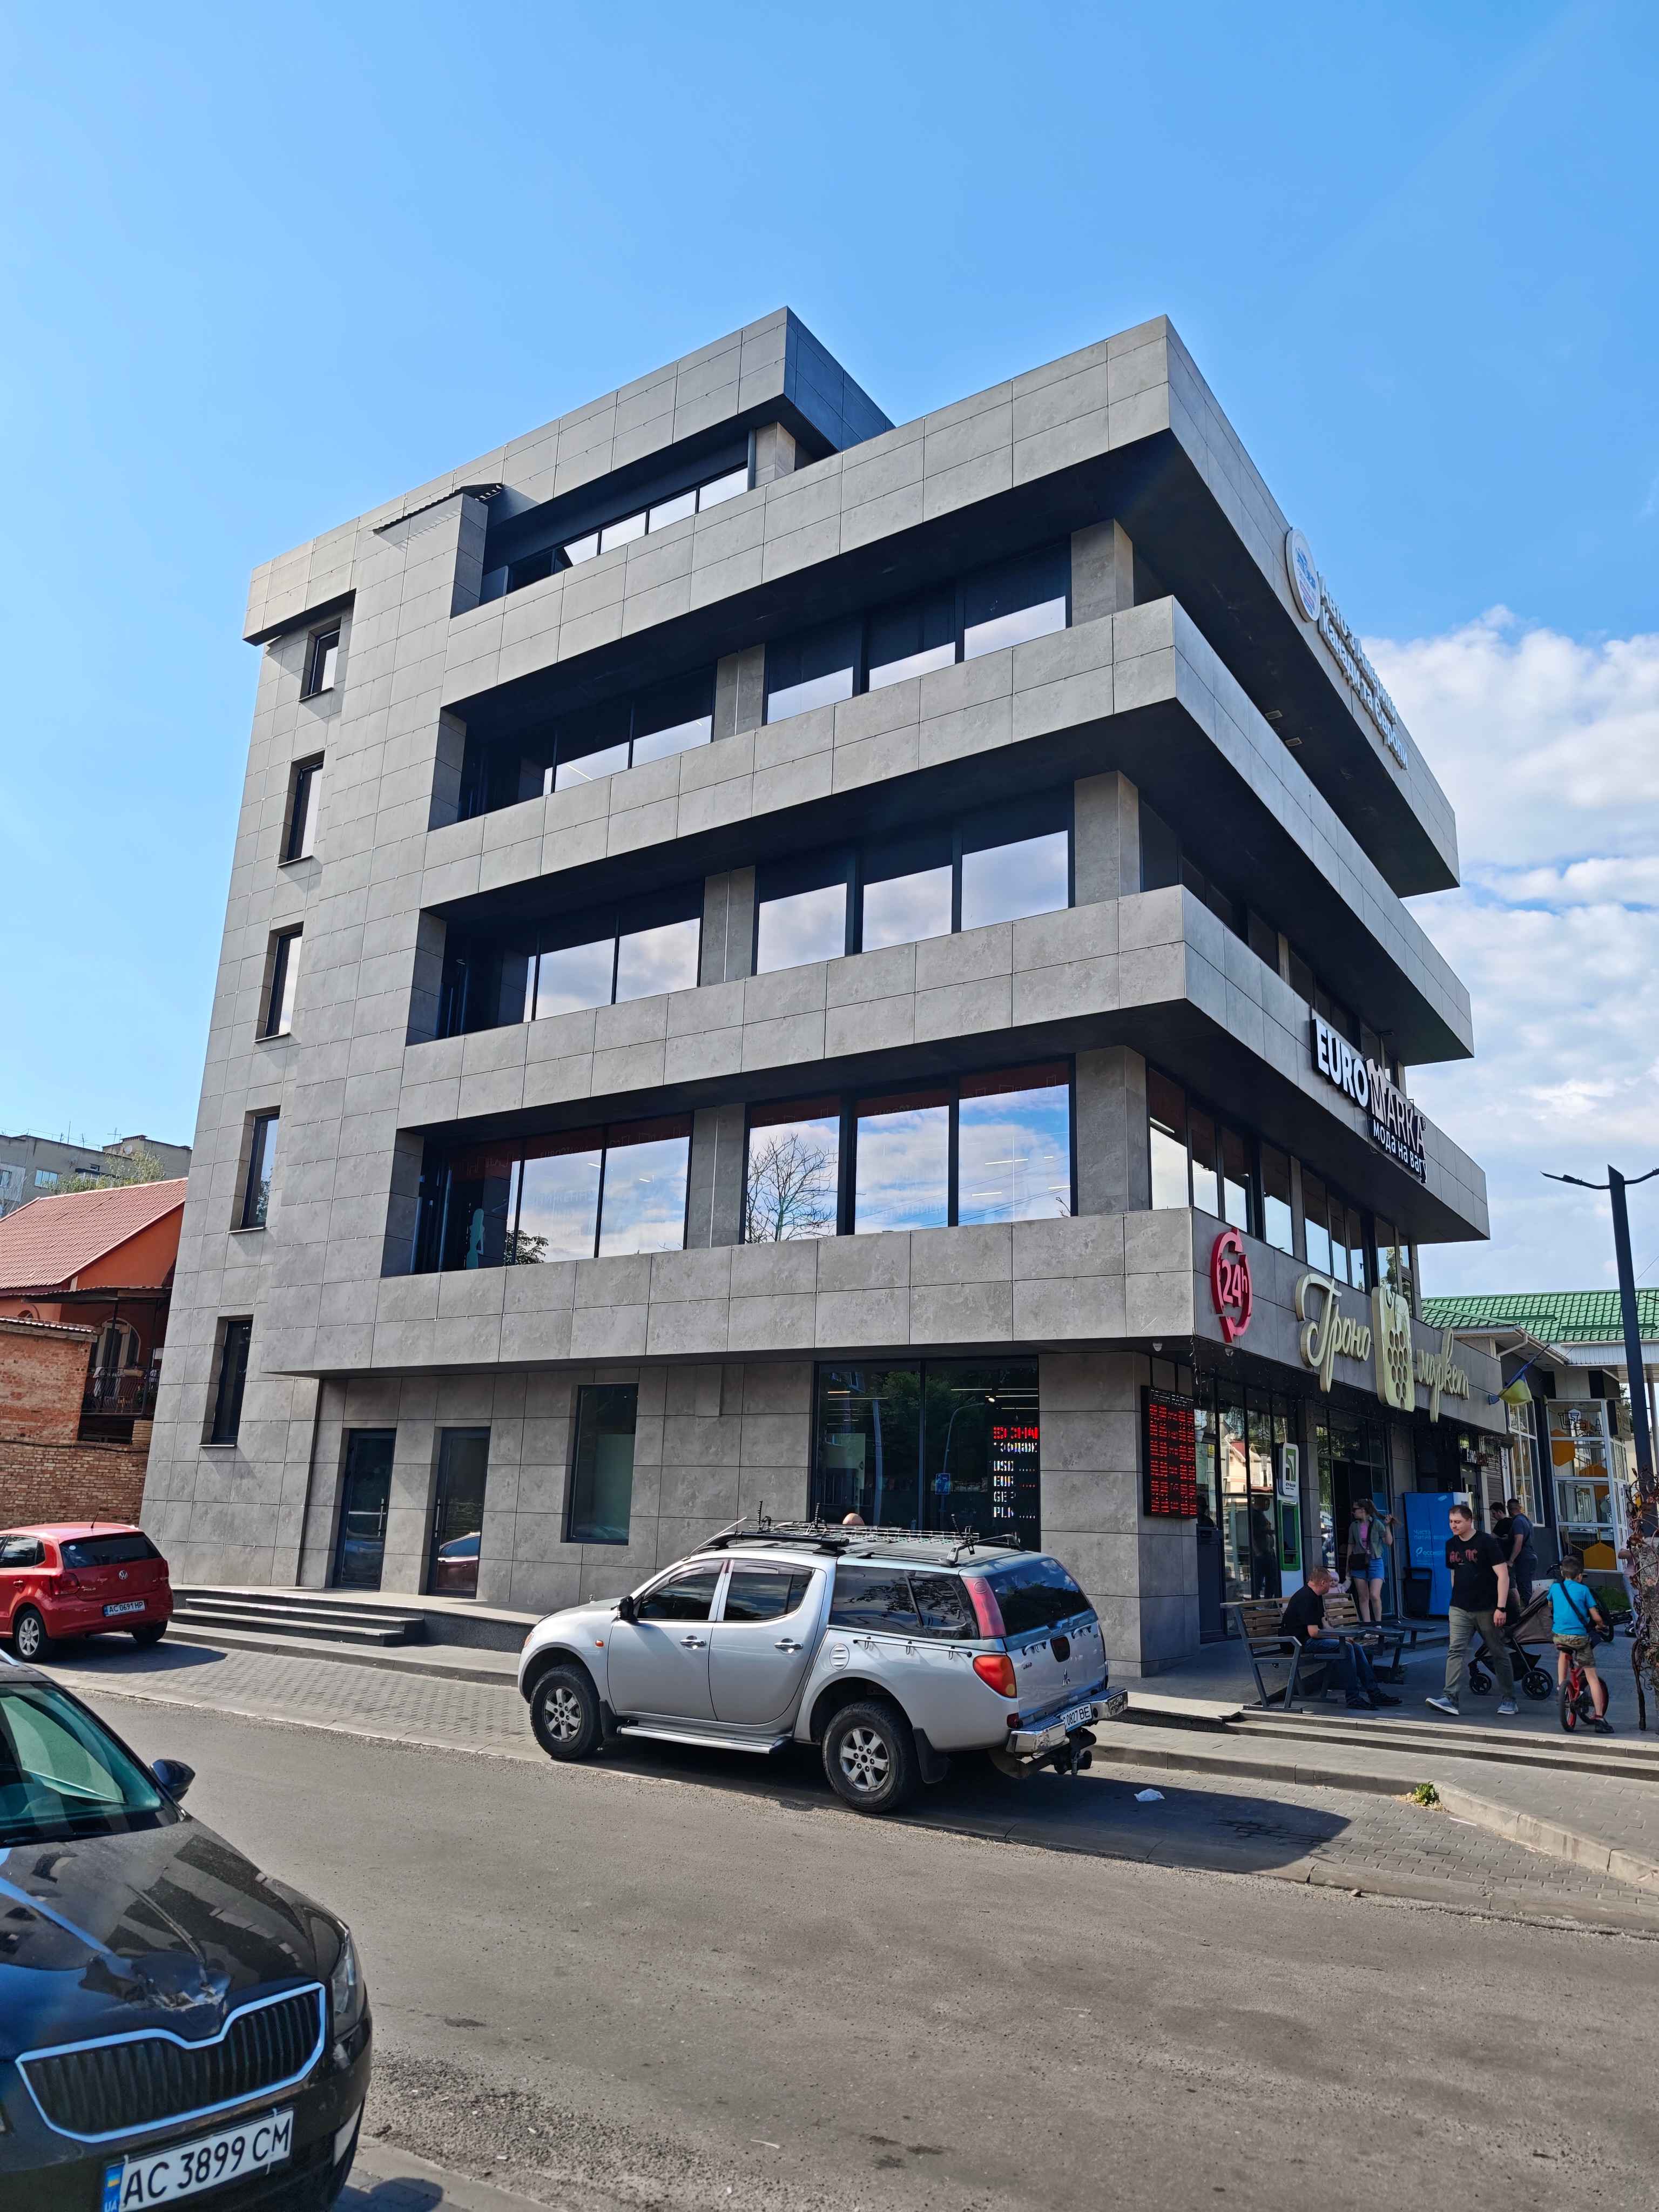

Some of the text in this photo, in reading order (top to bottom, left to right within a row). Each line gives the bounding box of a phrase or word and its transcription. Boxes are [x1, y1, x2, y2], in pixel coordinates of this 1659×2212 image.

[1320, 574, 1347, 637] Авто
[1321, 604, 1408, 770] Канади та Європи
[1398, 1141, 1408, 1164] на
[1410, 1151, 1427, 1184] вагу
[1222, 1258, 1247, 1307] 24h
[1298, 1273, 1371, 1393] Гроно
[123, 2118, 291, 2208] AC 3899 CM
